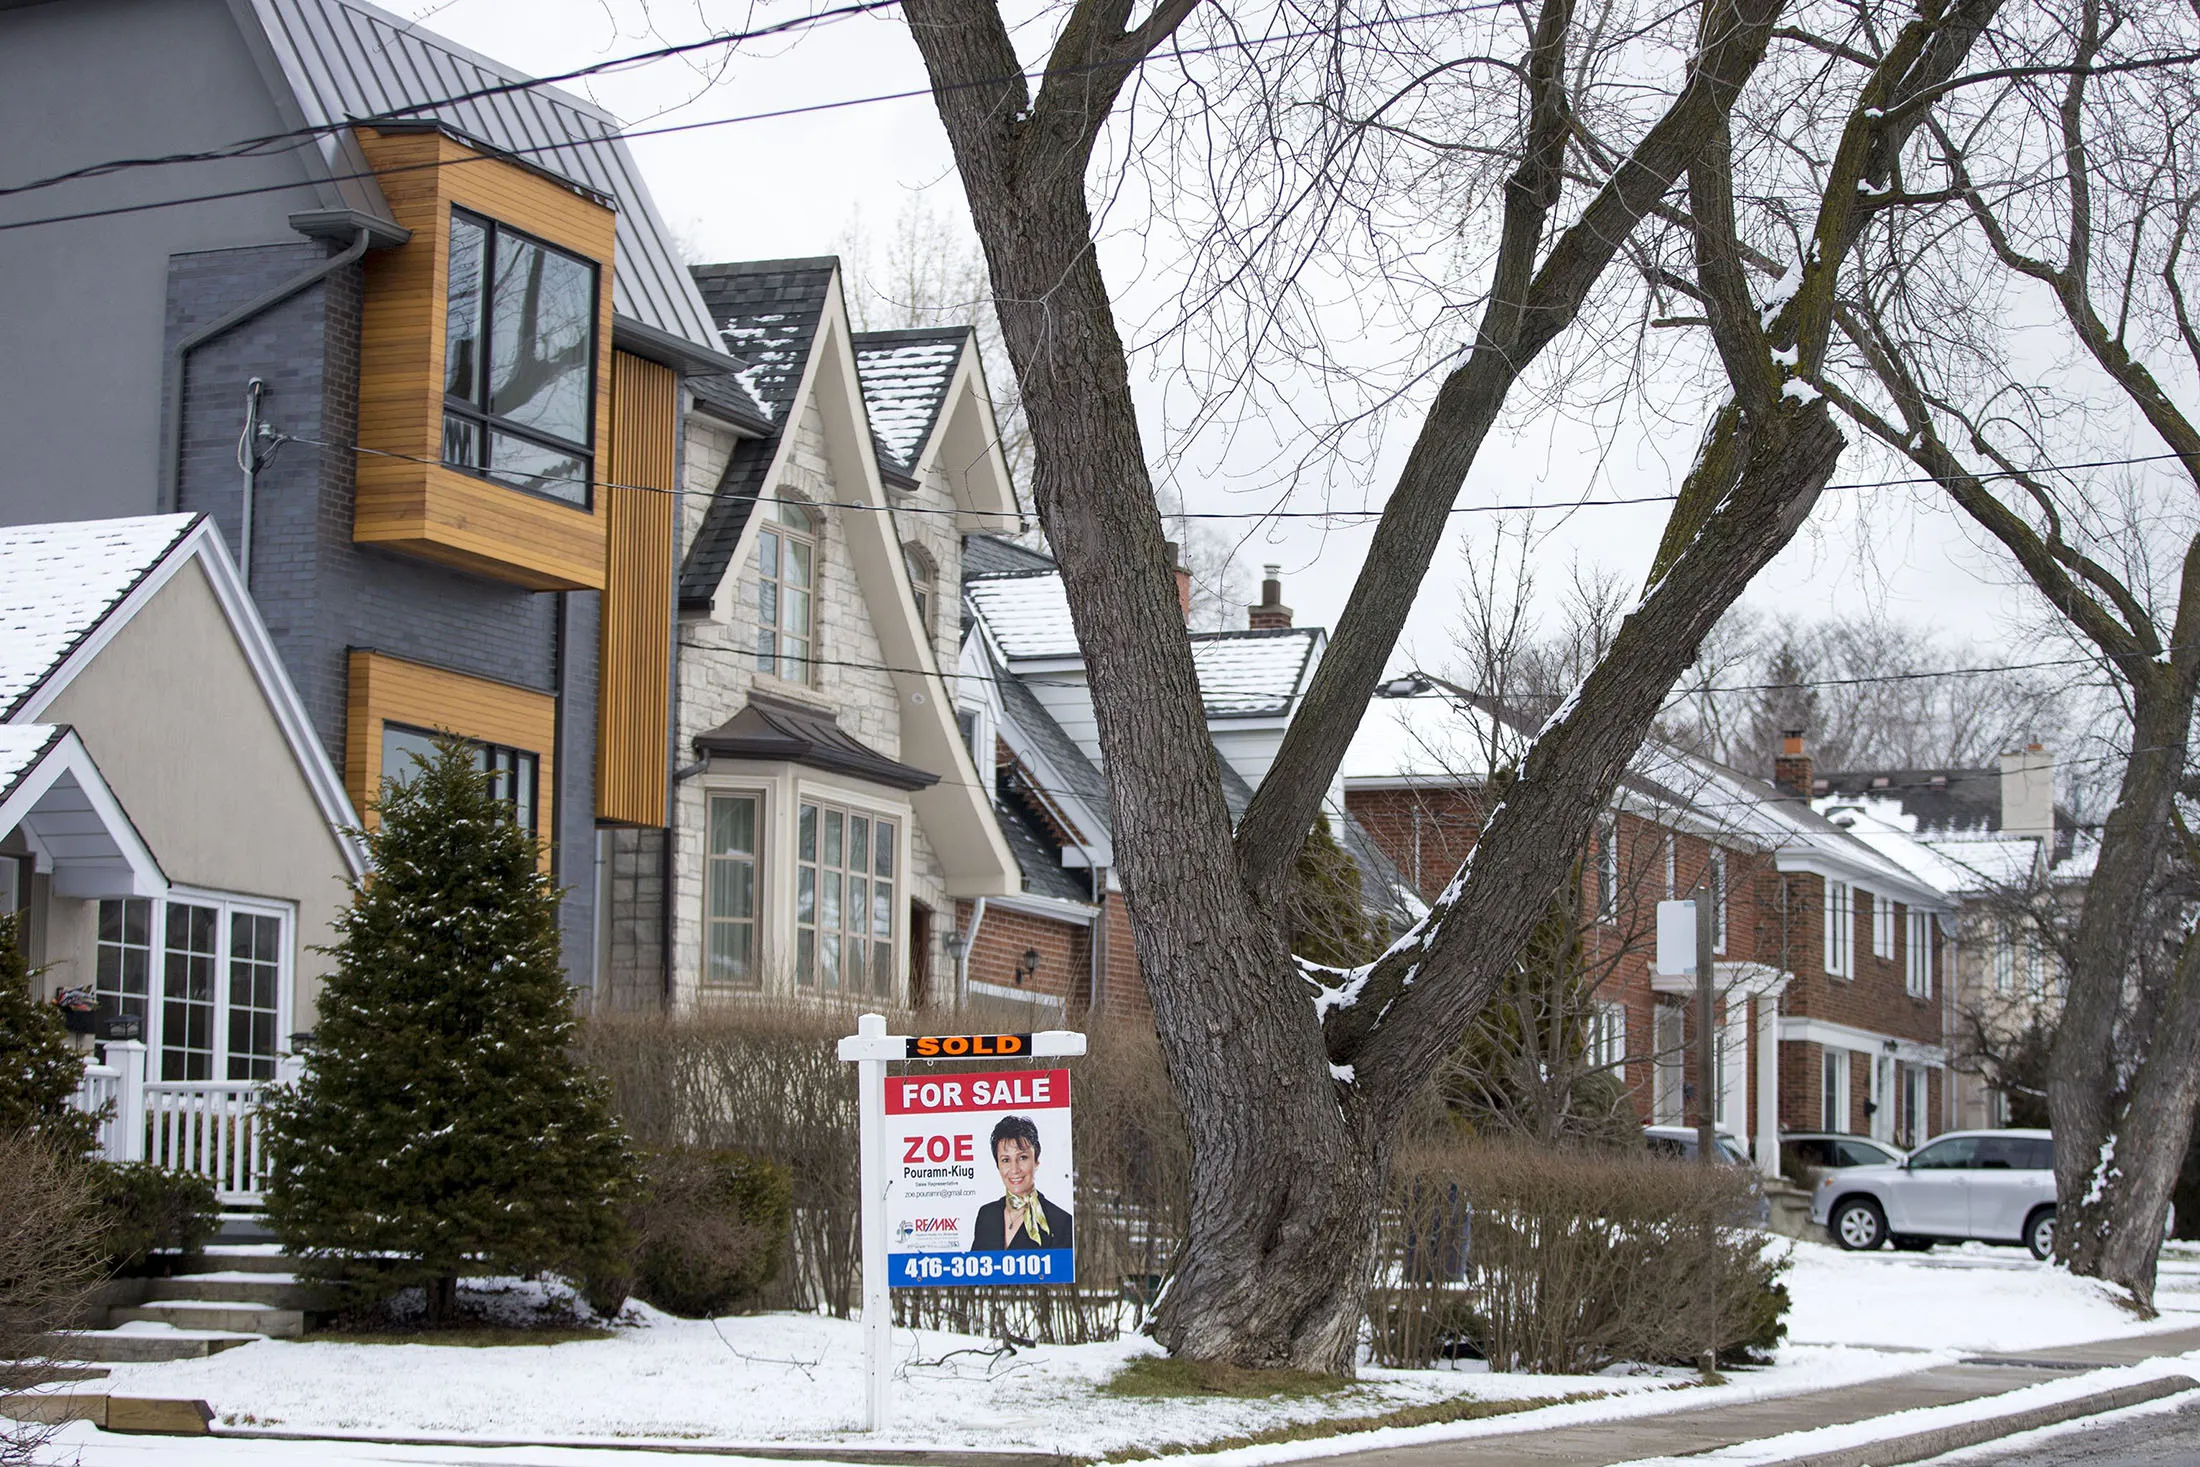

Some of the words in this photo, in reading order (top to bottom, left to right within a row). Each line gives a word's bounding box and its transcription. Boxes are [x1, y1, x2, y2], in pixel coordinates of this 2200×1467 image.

[916, 1035, 1022, 1055] SOLD
[903, 1082, 963, 1108] FOR
[972, 1078, 1051, 1105] SALE
[903, 1134, 974, 1164] ZOE
[915, 1217, 958, 1232] RE/MAX
[904, 1255, 1051, 1278] 416-303-0101
